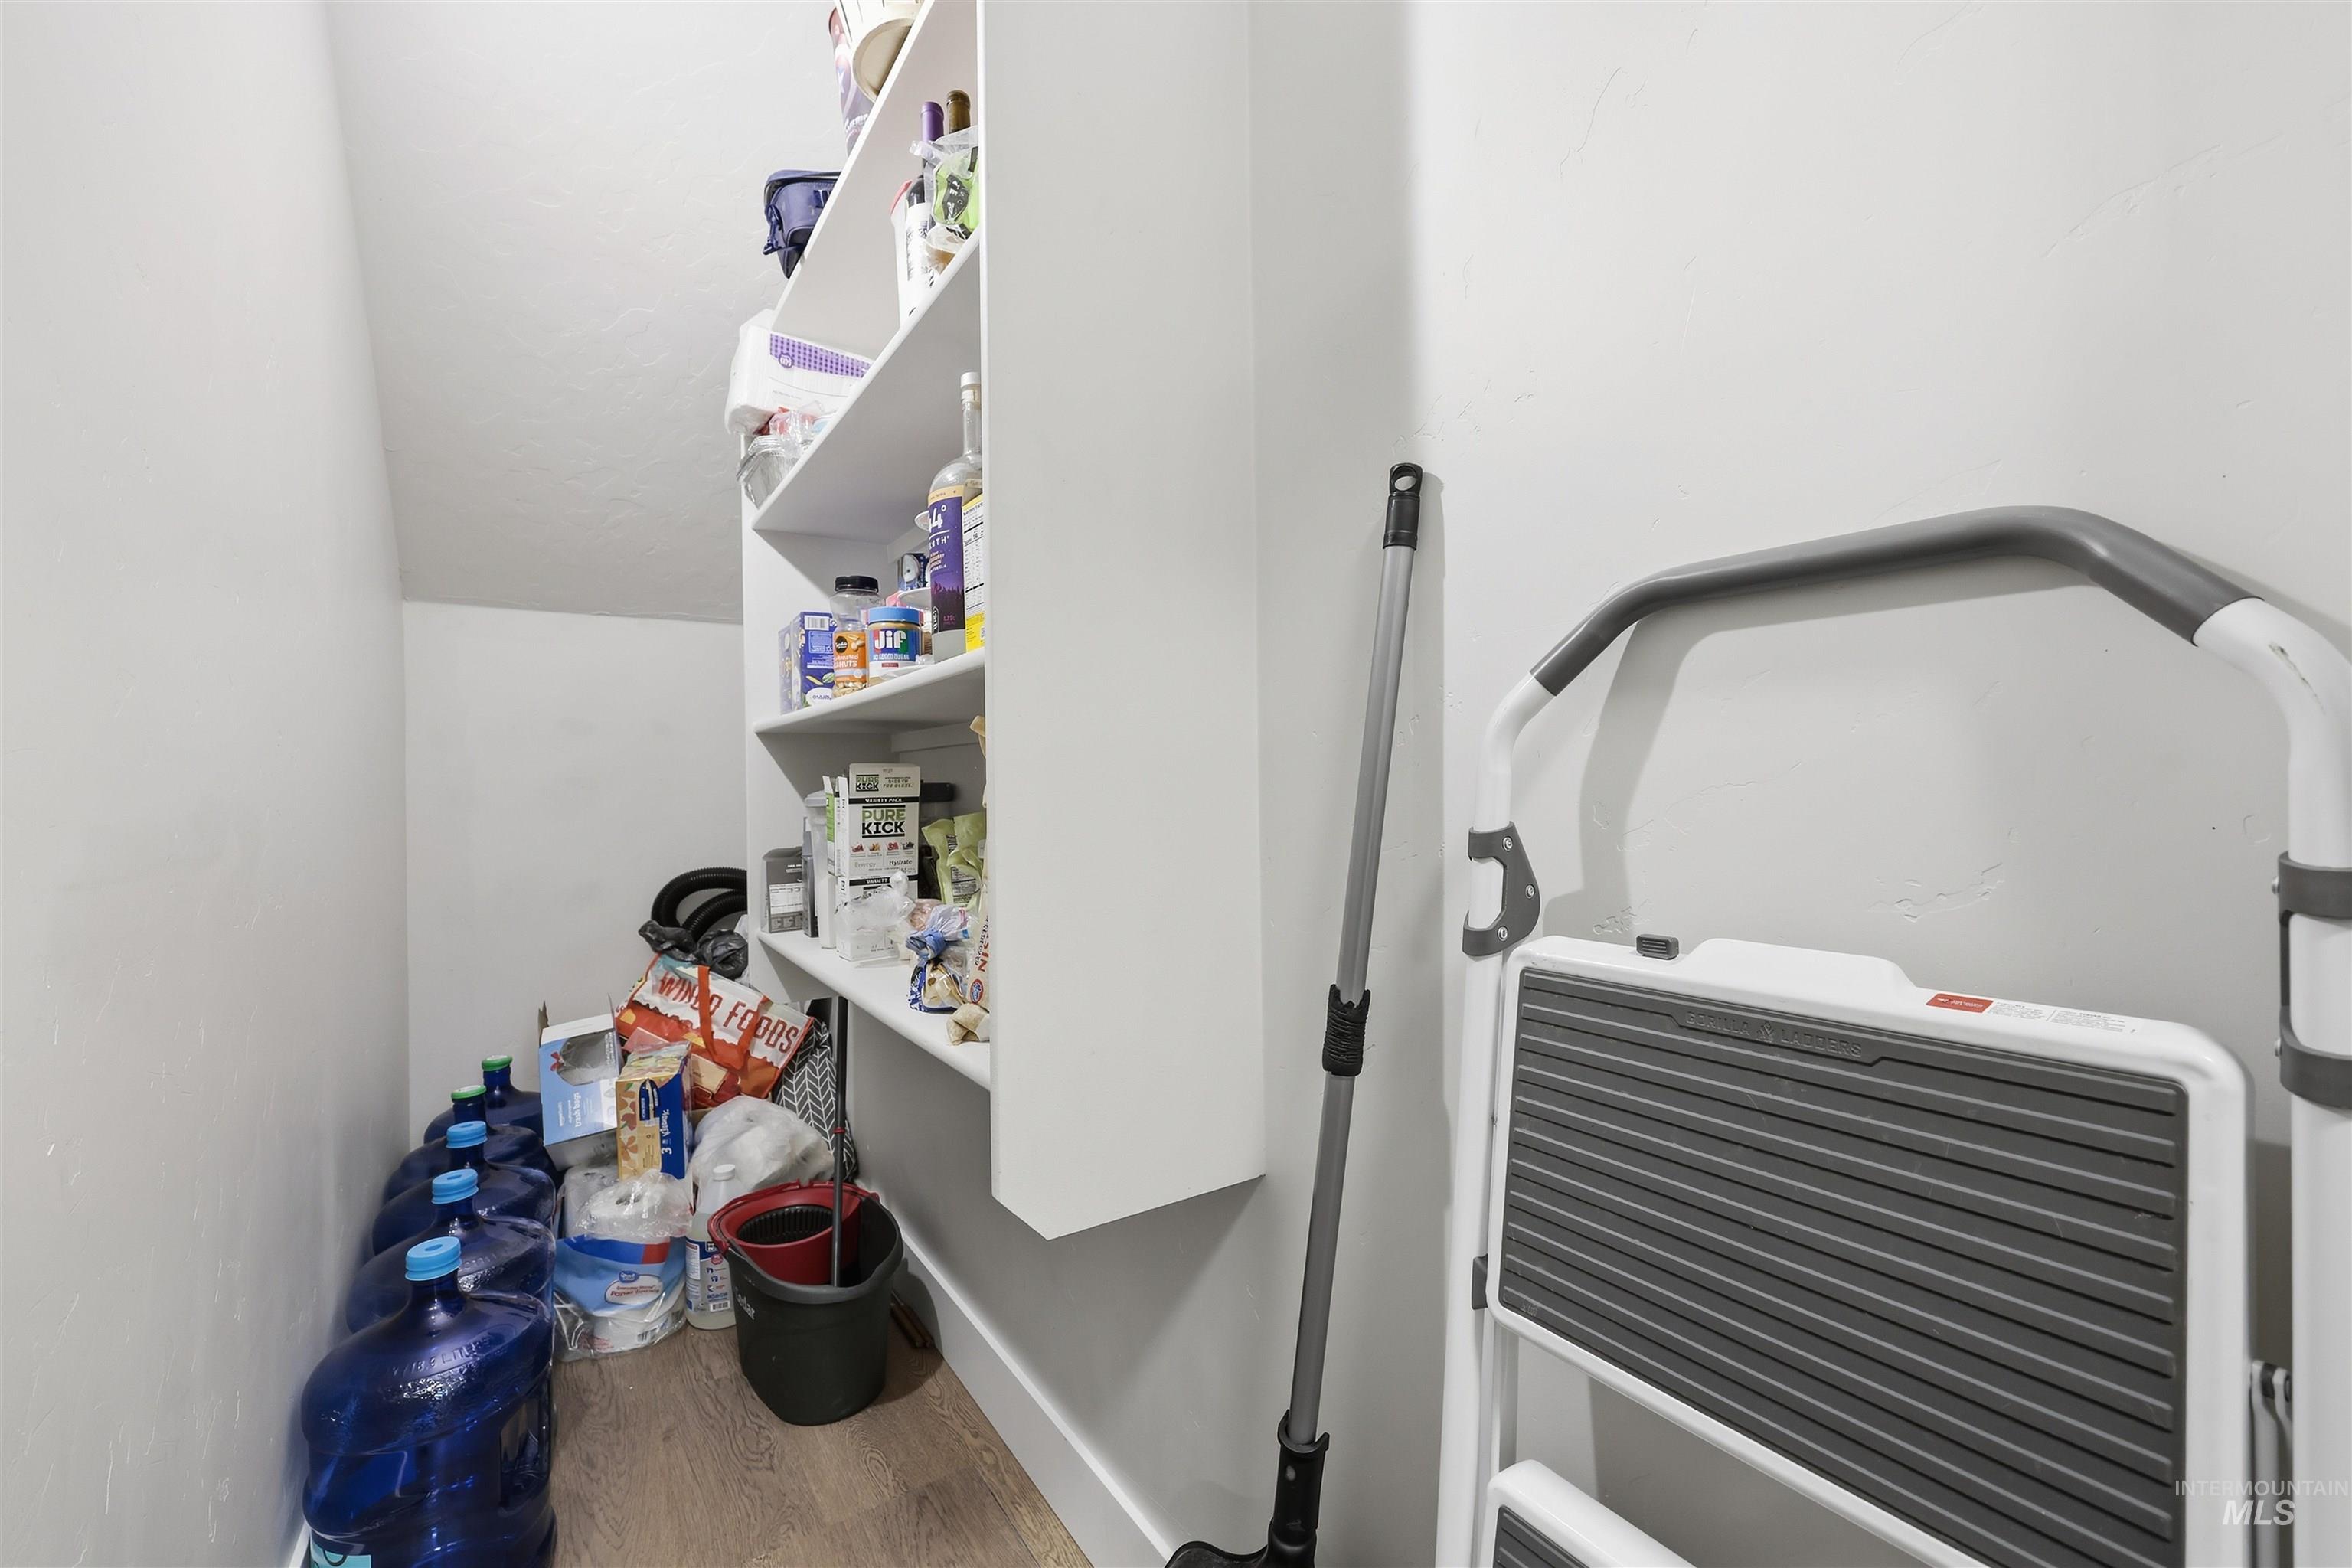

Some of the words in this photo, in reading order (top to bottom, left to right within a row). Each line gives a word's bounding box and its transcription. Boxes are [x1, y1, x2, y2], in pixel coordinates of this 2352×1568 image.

[874, 630, 906, 649] Jif
[862, 809, 906, 822] PURE
[862, 821, 905, 835] KICK
[723, 1000, 799, 1054] FOODS
[1686, 1011, 1751, 1036] GORILLA
[1780, 1028, 1862, 1058] LADDERS
[661, 1147, 672, 1155] 3
